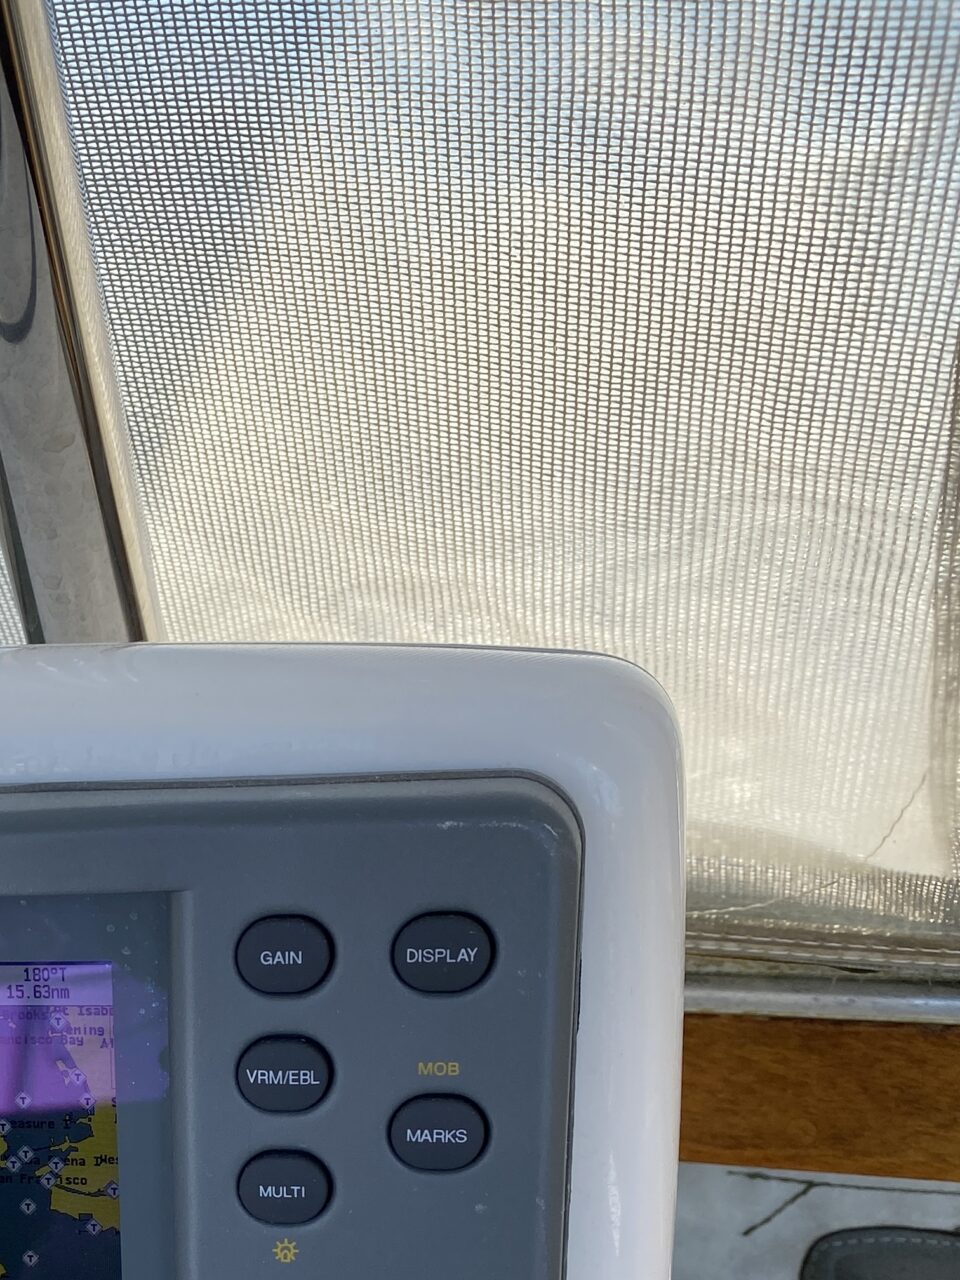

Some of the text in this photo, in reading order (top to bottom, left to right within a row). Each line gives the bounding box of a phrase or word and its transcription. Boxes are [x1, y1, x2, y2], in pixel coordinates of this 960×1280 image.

[260, 950, 302, 965] GAIN
[406, 947, 478, 963] DISPLAY
[6, 984, 70, 999] 15.63nm
[418, 1062, 460, 1076] MOB
[246, 1069, 320, 1085] VRM/EBL
[406, 1129, 468, 1143] MARKS
[259, 1184, 305, 1198] MULTI
